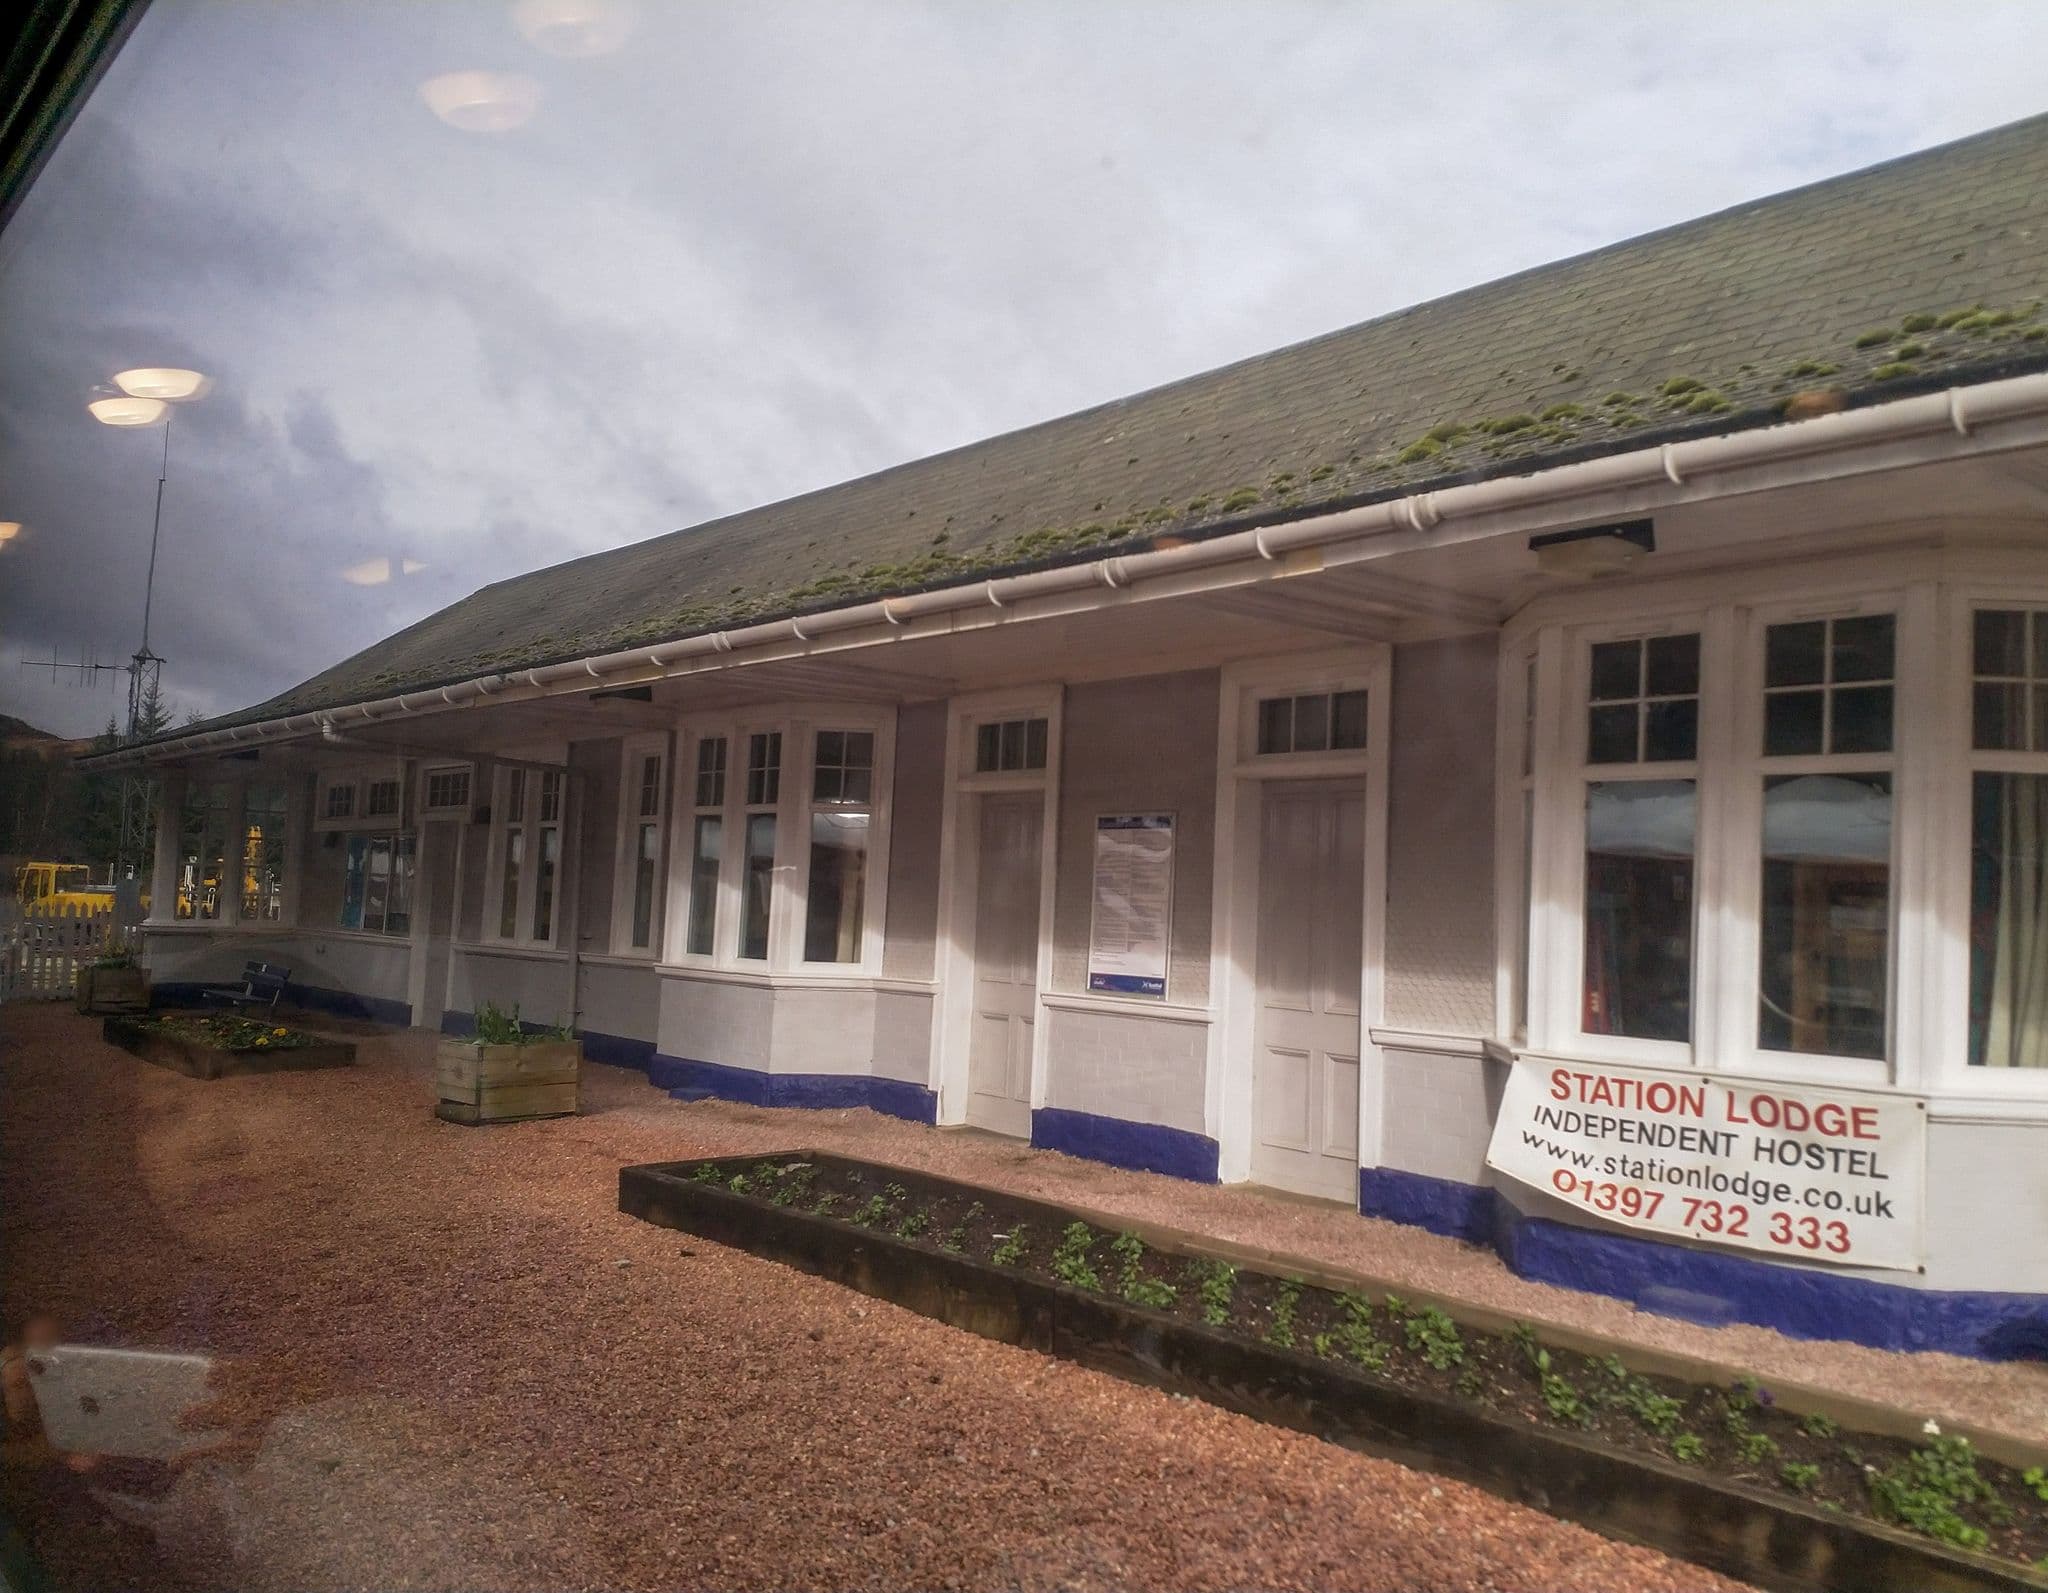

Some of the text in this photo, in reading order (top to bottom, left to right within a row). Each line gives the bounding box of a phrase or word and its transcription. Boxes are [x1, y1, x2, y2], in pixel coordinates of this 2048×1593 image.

[1534, 1104, 1889, 1179] INDEPENDENT HOSTEL
[1550, 1068, 1880, 1140] STATION LODGE
[1522, 1129, 1894, 1219] www.stationlodge.co.uk
[1551, 1167, 1852, 1254] 01397 732 333
